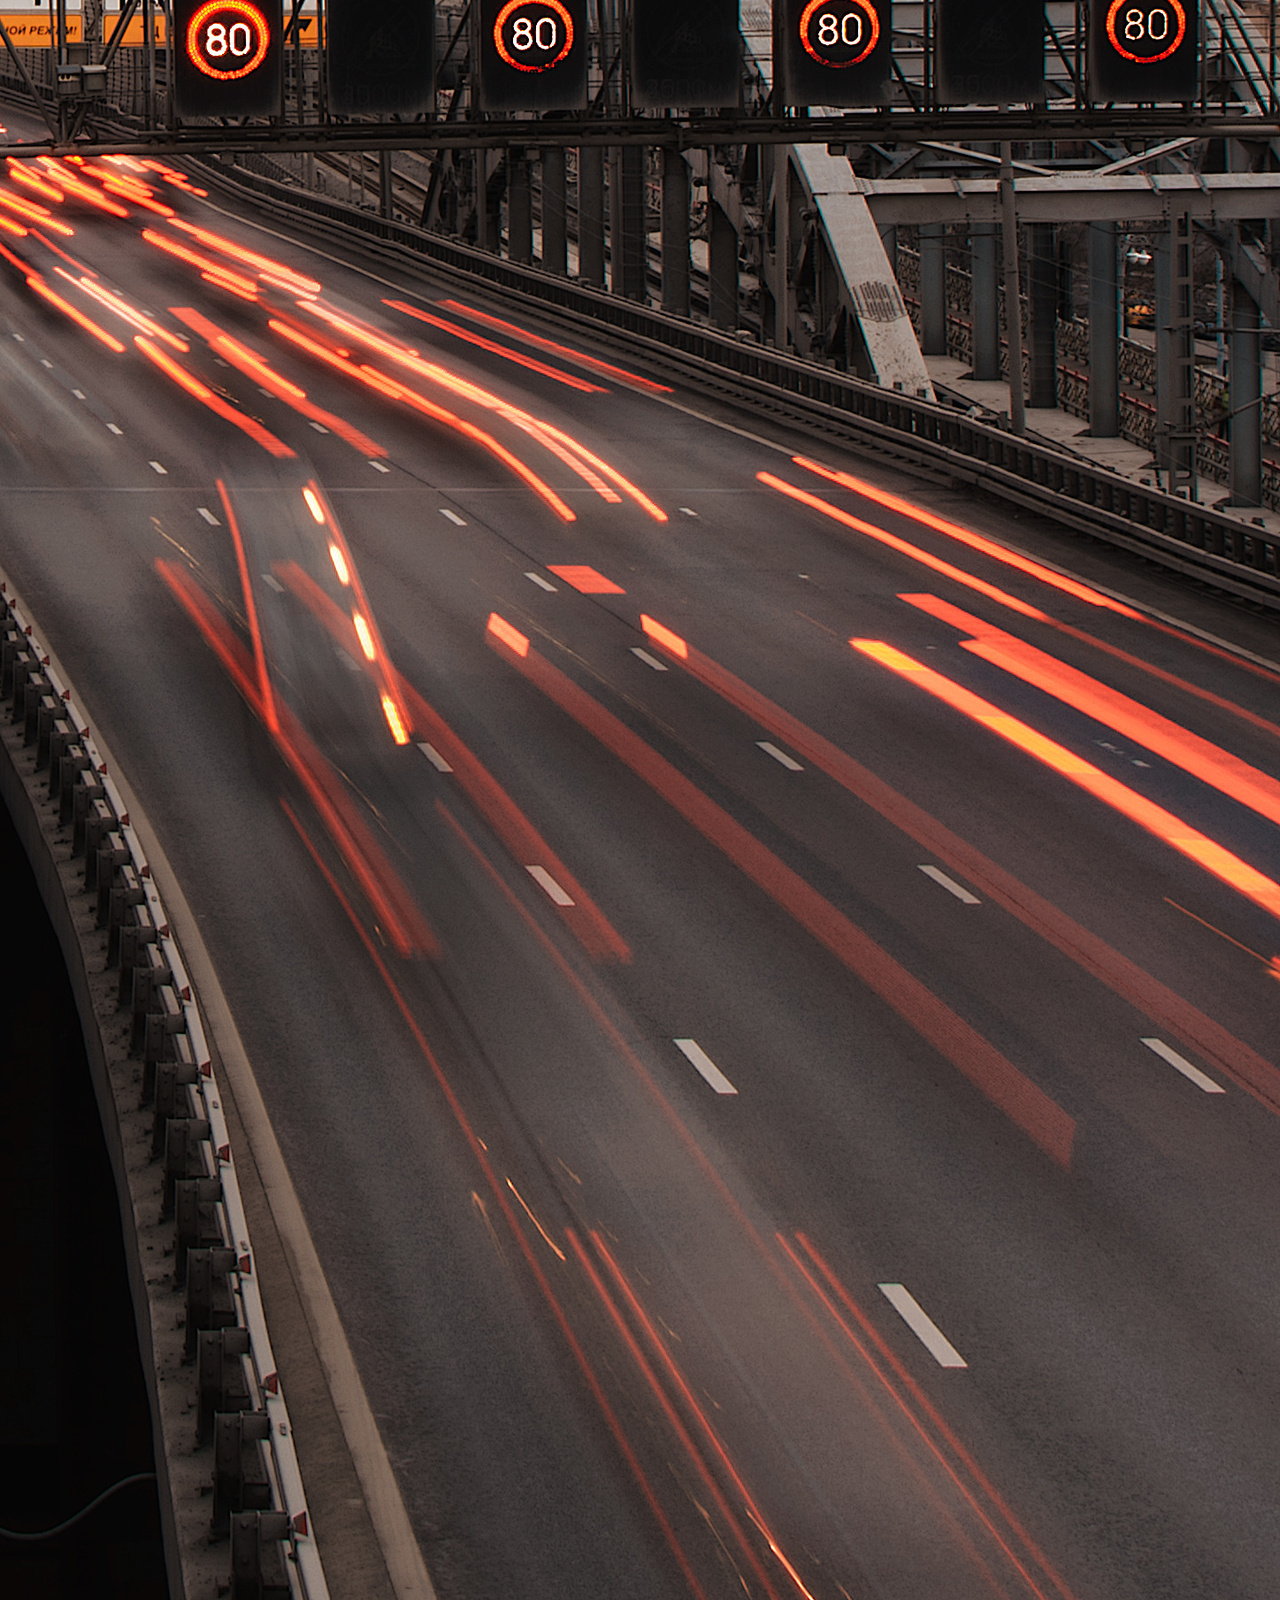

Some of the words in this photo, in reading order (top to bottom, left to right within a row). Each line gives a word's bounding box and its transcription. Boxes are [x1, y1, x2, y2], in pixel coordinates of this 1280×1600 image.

[205, 22, 251, 56] 80
[513, 17, 557, 50] 80
[818, 12, 862, 46] 80
[1125, 8, 1168, 40] 80
